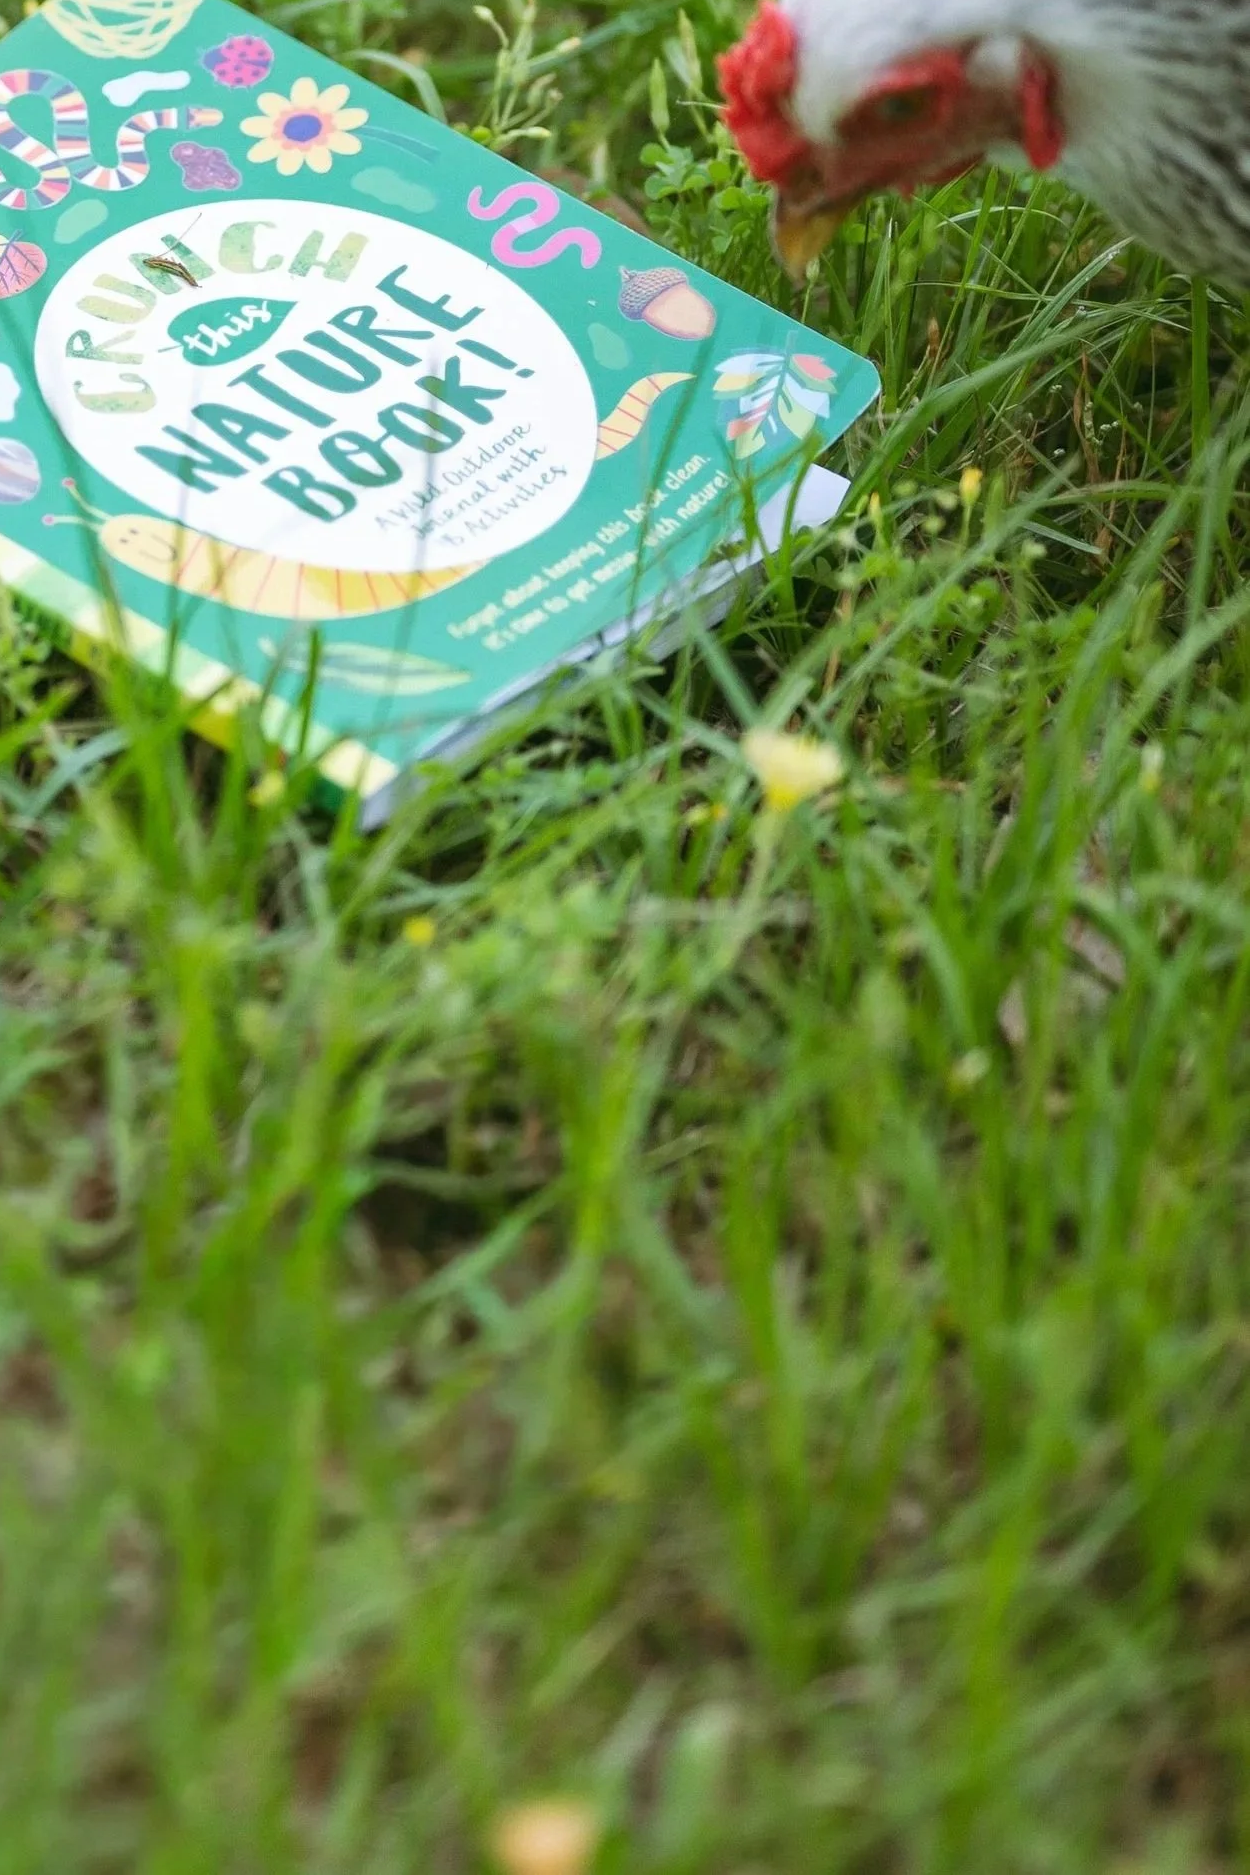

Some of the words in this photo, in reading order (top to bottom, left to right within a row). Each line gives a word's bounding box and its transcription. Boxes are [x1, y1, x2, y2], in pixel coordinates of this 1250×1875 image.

[66, 221, 369, 414] CRUNCH
[183, 300, 271, 357] this
[134, 264, 485, 494] NATURE
[261, 339, 535, 523] BOOK!
[497, 445, 546, 483] with
[464, 463, 567, 537] Activities
[542, 541, 605, 579] keeping
[596, 520, 629, 544] this
[665, 454, 711, 490] clean.
[677, 470, 730, 520] nature!
